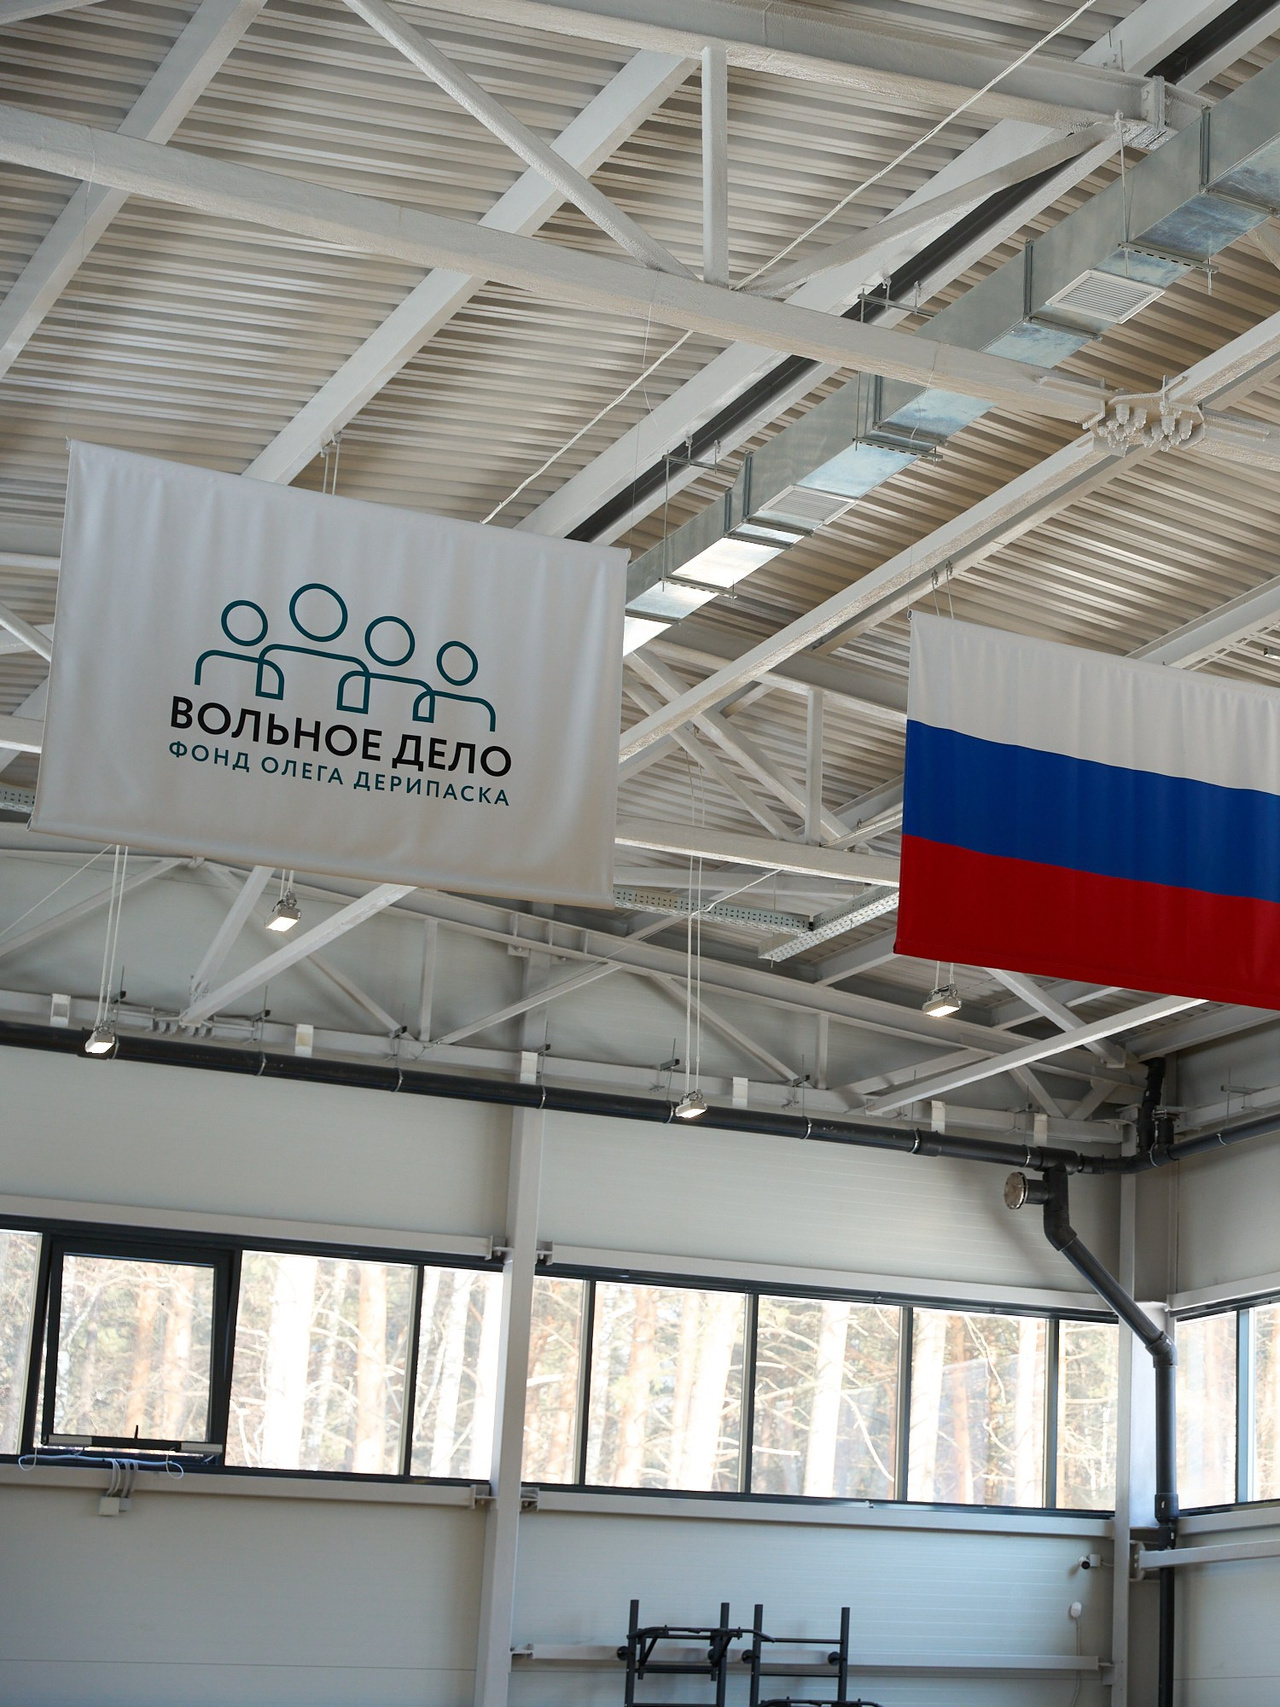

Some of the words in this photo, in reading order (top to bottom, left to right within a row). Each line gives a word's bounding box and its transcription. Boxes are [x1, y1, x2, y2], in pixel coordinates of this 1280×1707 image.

[170, 695, 382, 762] ВОЛЬНОЕ
[391, 733, 512, 777] ДЕЛО
[168, 740, 250, 773] ФОНД
[261, 756, 343, 785] ОЛЕГА
[353, 770, 510, 807] ДЕРИПАСКА
